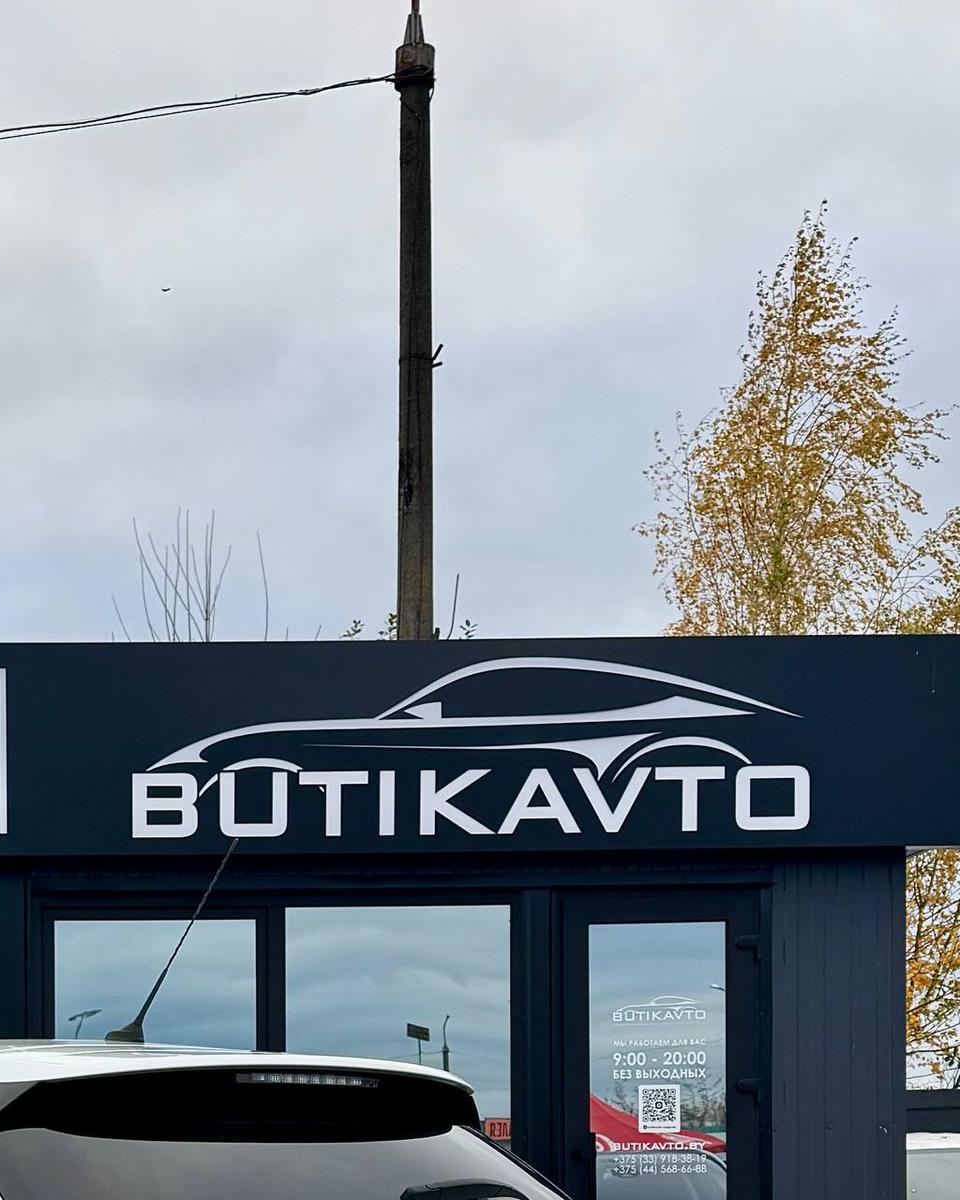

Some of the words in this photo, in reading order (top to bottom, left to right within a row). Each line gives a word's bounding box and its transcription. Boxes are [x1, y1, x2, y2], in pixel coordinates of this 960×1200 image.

[131, 764, 811, 838] BUTIKAVTO
[612, 1009, 706, 1022] BUTIKAVTO
[613, 1040, 628, 1048] МЫ
[628, 1039, 671, 1047] РАБОТАЕМ
[671, 1039, 688, 1047] ДЛЯ
[613, 1052, 646, 1066] 9:00
[662, 1051, 707, 1065] 20:00
[613, 1069, 632, 1079] БЕЗ
[635, 1068, 707, 1080] ВЫХОДНЫХ
[613, 1141, 707, 1152] BUTIKAVTO.BY
[613, 1154, 638, 1165] +375
[639, 1154, 658, 1166] (33)
[660, 1153, 707, 1164] 918-38-19
[613, 1164, 638, 1175] +375
[639, 1164, 658, 1176] (44)
[660, 1164, 708, 1174] 568-66-88
